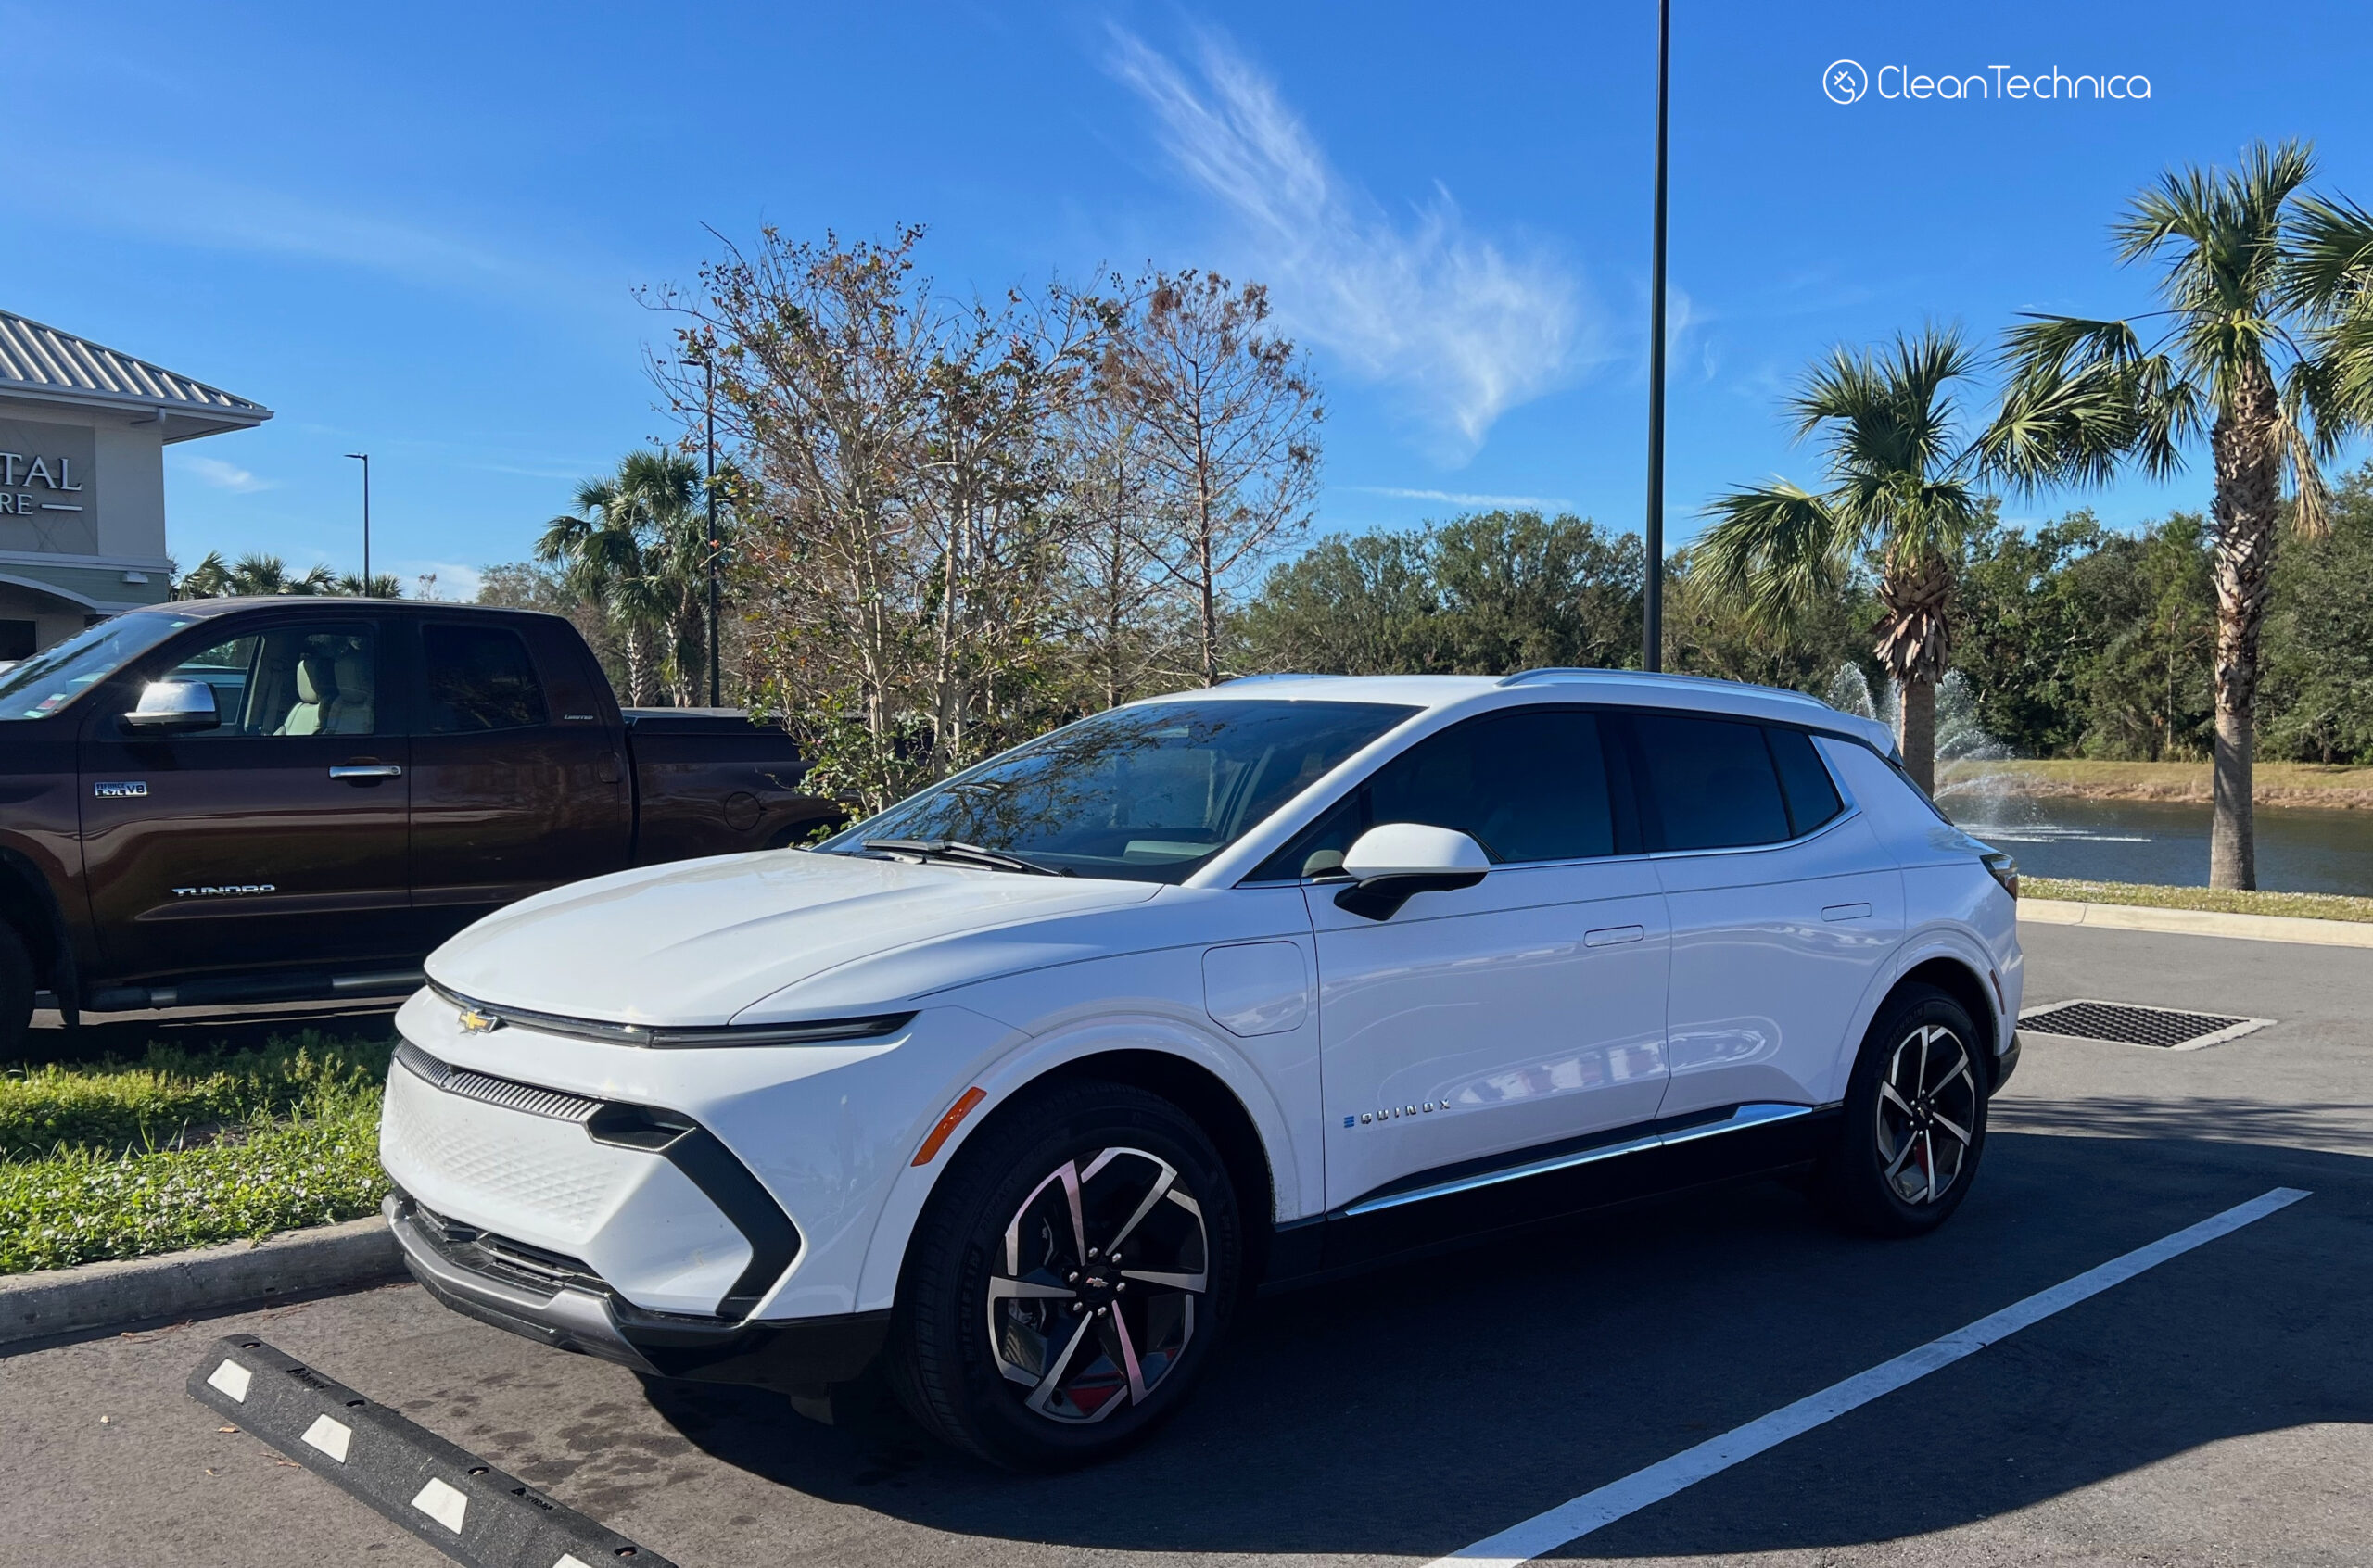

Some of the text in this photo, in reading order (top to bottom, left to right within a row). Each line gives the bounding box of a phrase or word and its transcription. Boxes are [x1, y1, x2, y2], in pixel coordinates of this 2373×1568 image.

[126, 784, 146, 794] V8
[171, 883, 276, 897] TUNDRA
[1343, 1098, 1451, 1128] EQUINOX
[957, 1247, 982, 1363] MICHELIN
